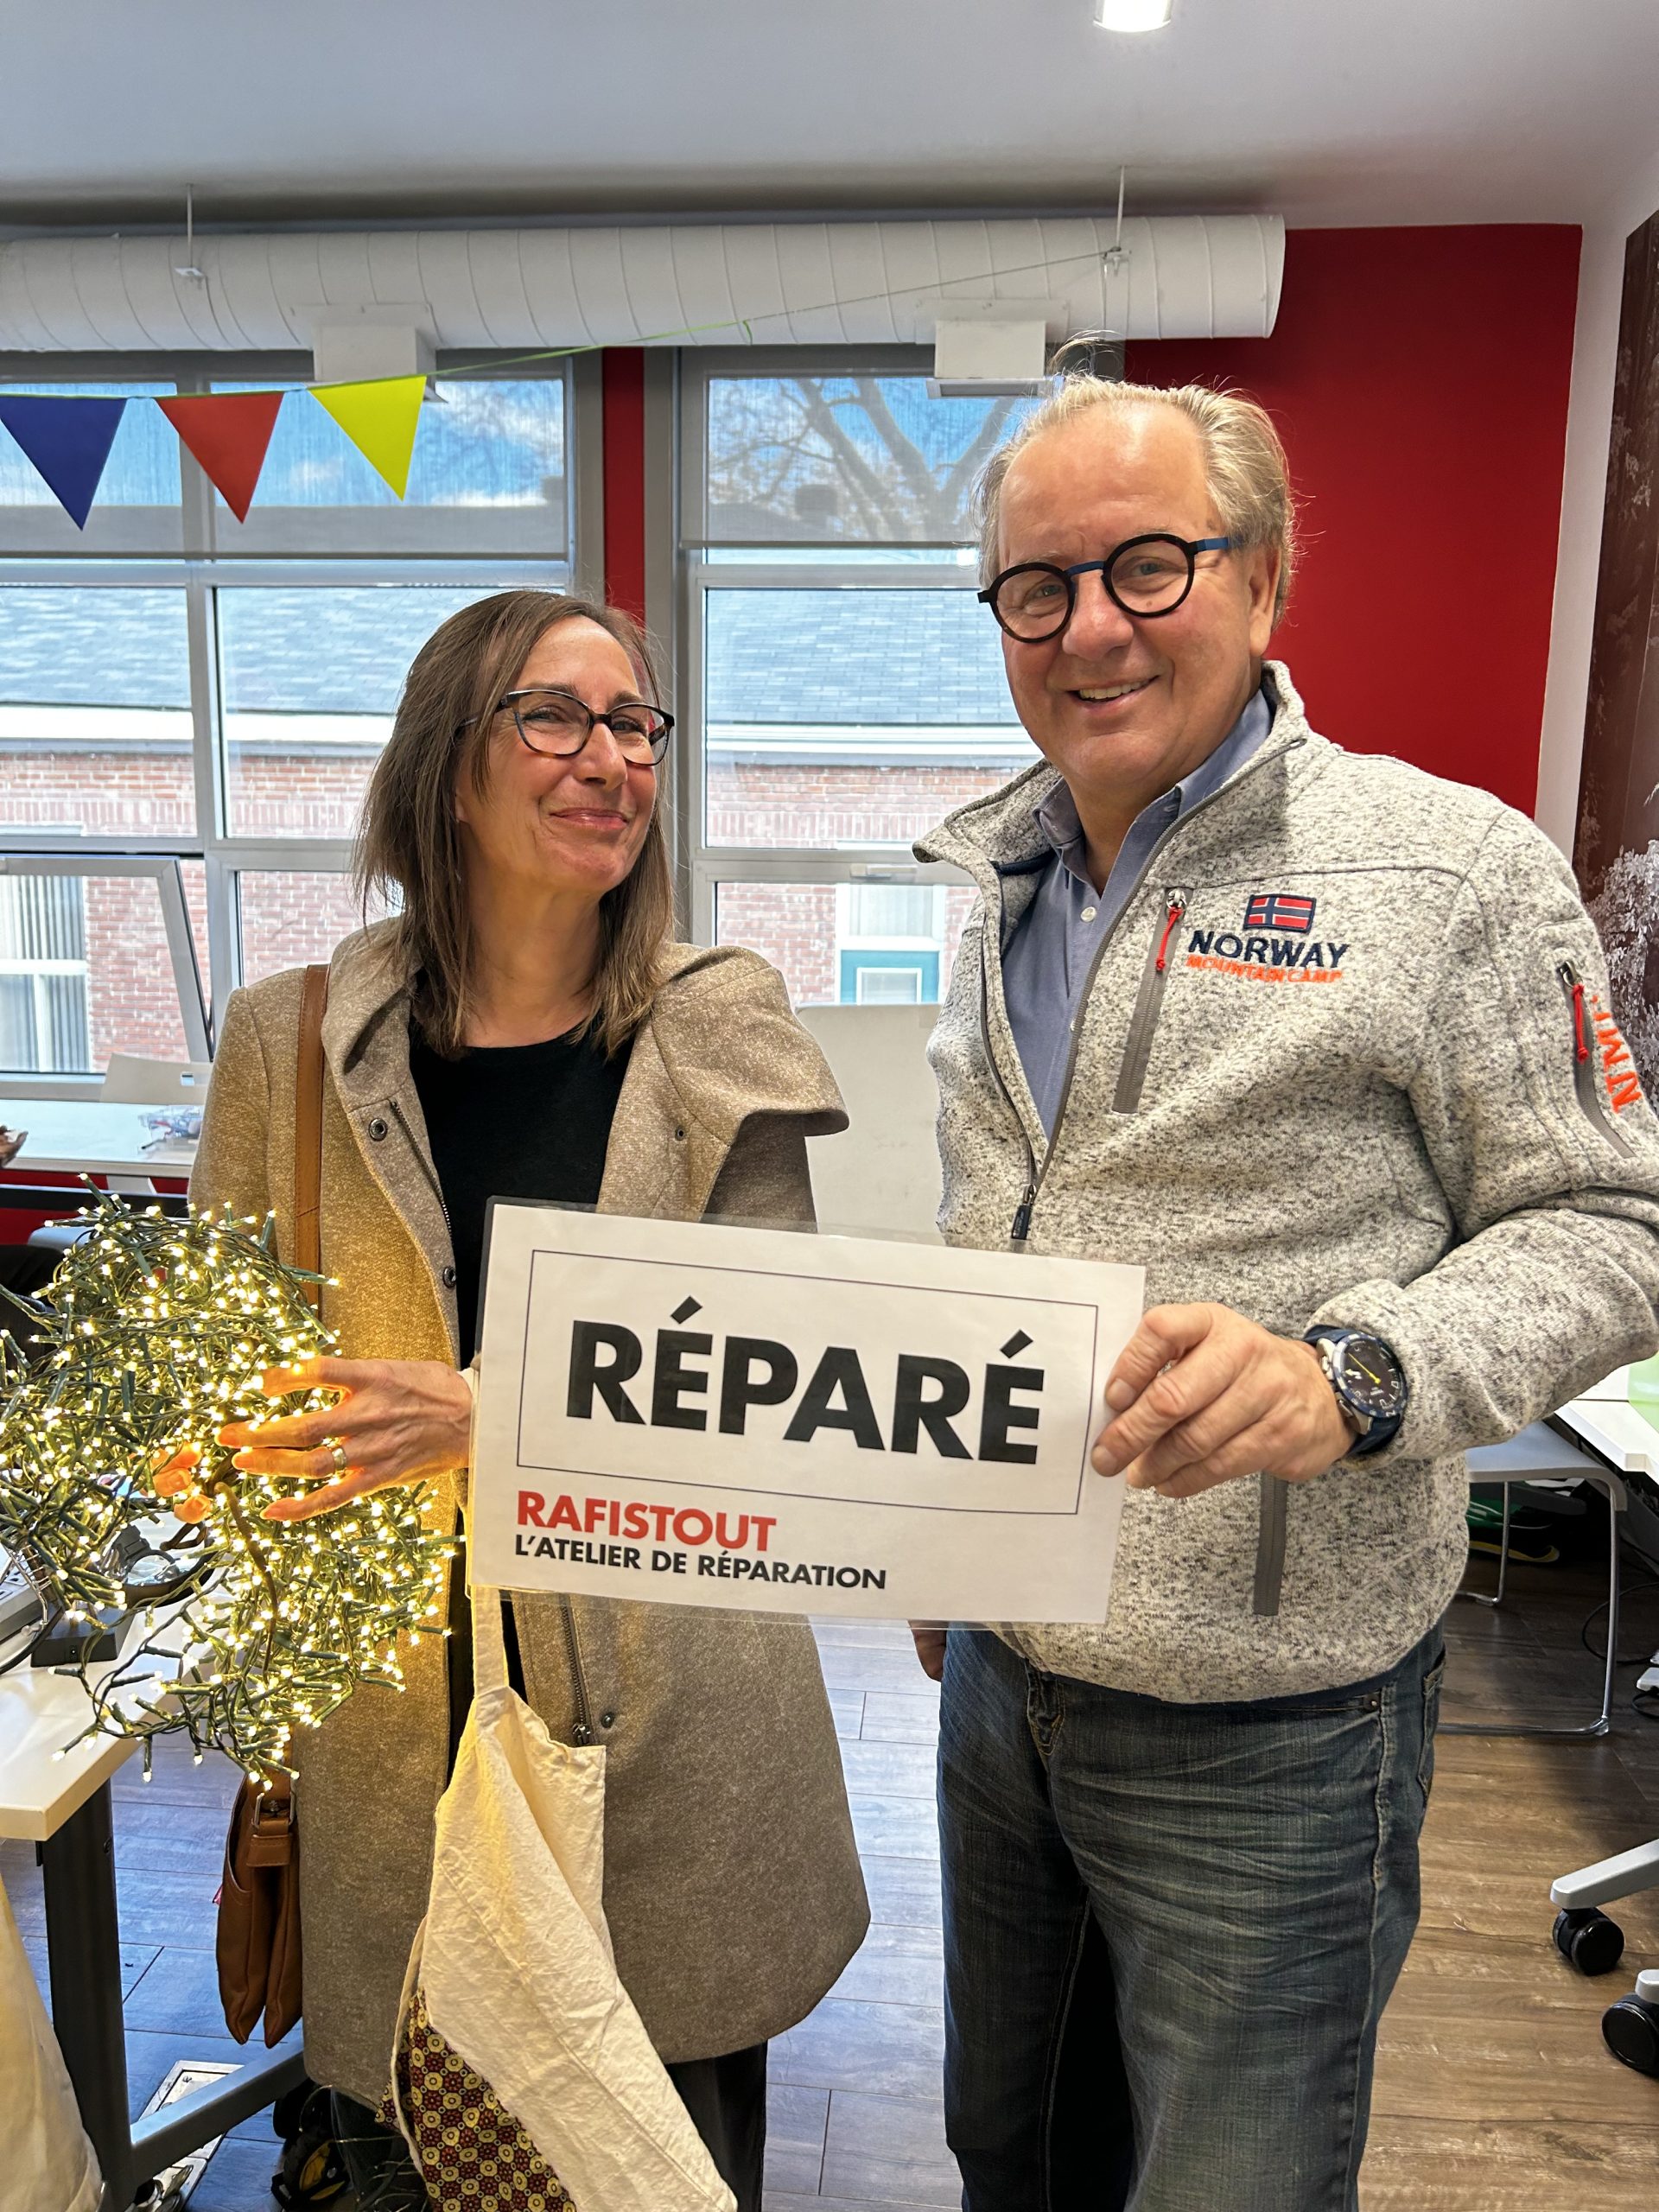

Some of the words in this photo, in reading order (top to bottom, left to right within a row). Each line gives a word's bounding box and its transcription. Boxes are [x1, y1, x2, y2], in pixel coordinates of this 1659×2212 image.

[1185, 954, 1285, 982] MOUNTAIN
[1287, 968, 1344, 983] CAMP
[1188, 930, 1350, 969] NORWAY
[567, 1296, 1045, 1465] RÉPARÉ
[517, 1491, 778, 1552] RAFISTOUT
[652, 1550, 687, 1574] DE
[697, 1550, 887, 1590] RÉPARATION
